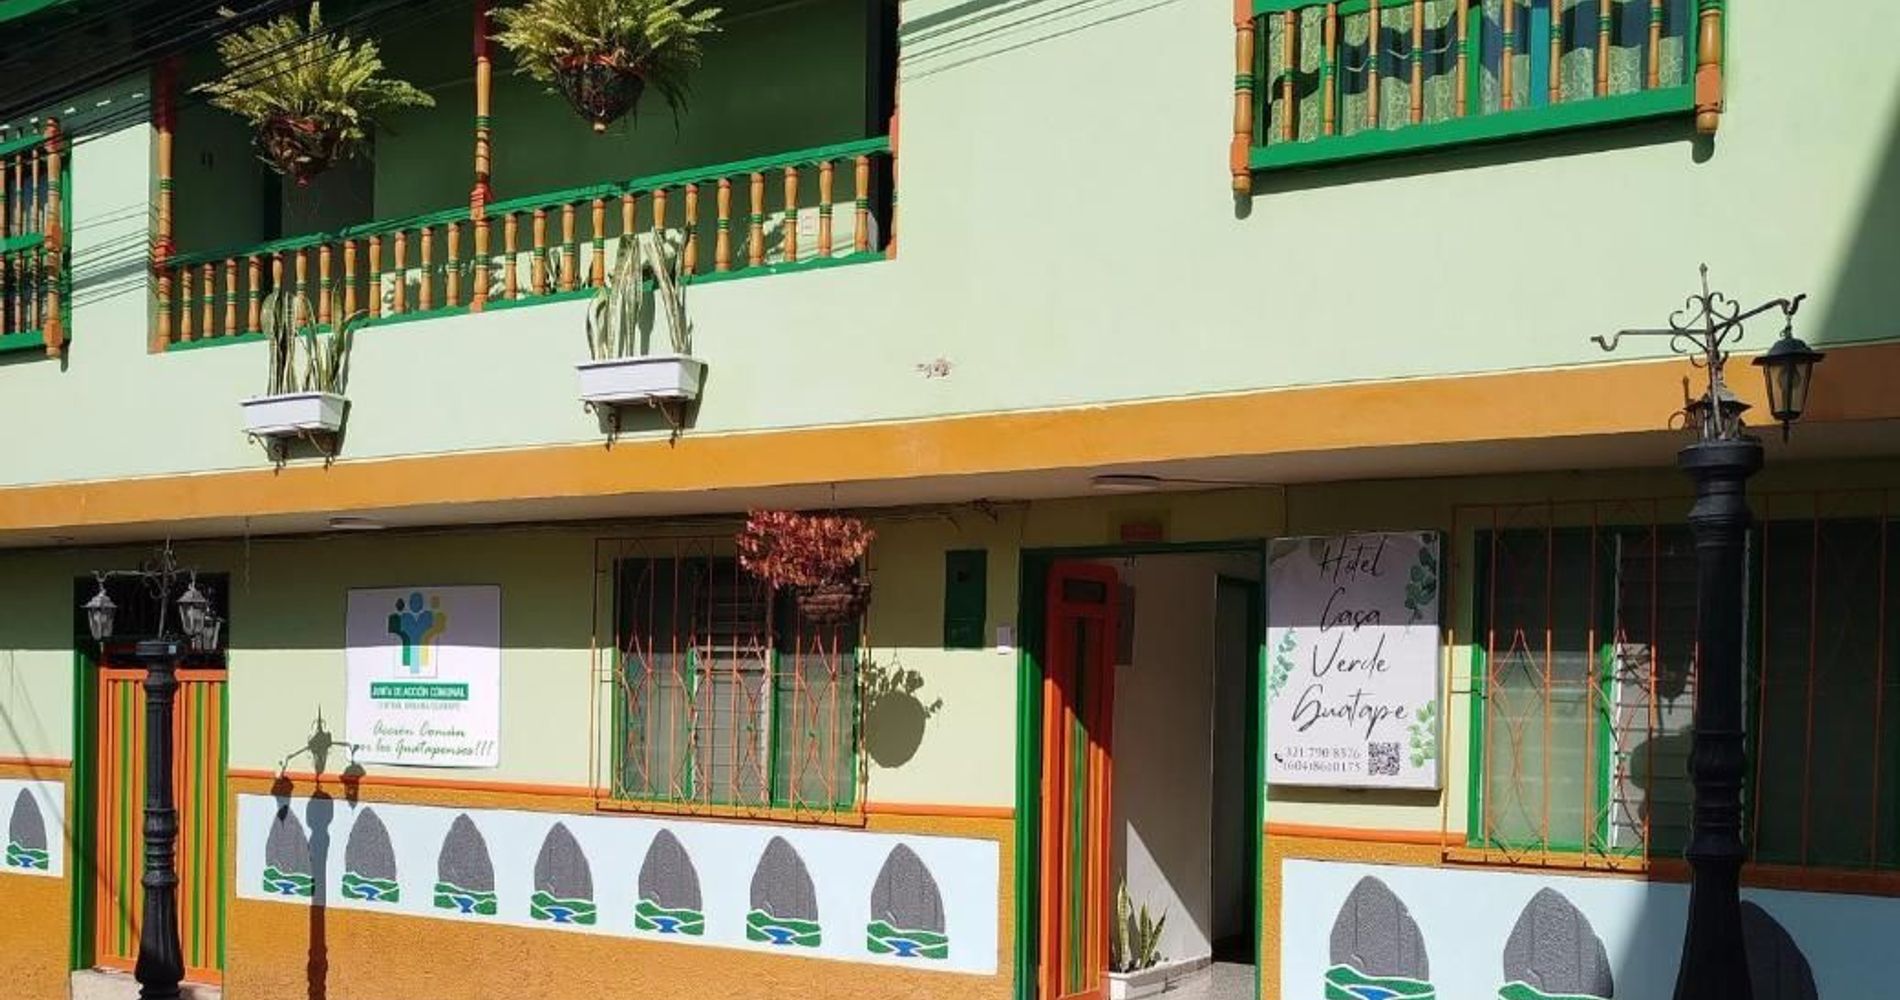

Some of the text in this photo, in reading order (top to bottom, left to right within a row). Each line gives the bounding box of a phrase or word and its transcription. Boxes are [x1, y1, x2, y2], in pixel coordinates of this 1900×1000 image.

[1319, 536, 1387, 583] Hotel
[1320, 586, 1380, 632] Casa
[1312, 632, 1391, 679] Verde
[1291, 683, 1408, 740] Guatape
